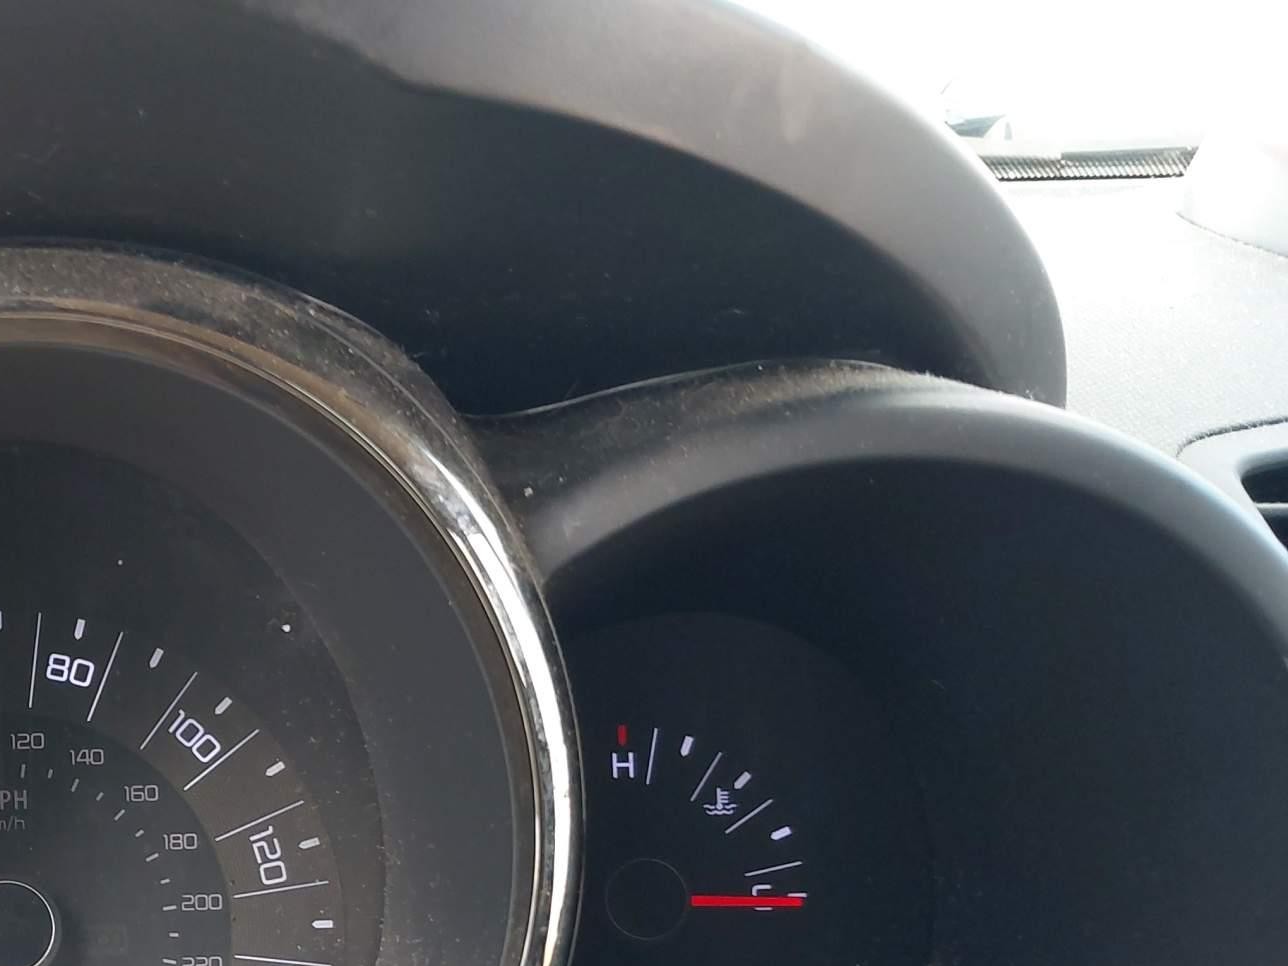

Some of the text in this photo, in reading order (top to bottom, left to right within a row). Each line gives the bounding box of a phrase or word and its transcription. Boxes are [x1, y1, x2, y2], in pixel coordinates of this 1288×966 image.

[46, 653, 96, 688] 80
[11, 732, 45, 751] 120
[168, 709, 221, 764] 100
[70, 748, 105, 765] 140
[611, 751, 635, 779] H
[124, 784, 159, 802] 160
[163, 833, 198, 850] 180
[249, 826, 287, 885] 120
[181, 894, 223, 911] 200
